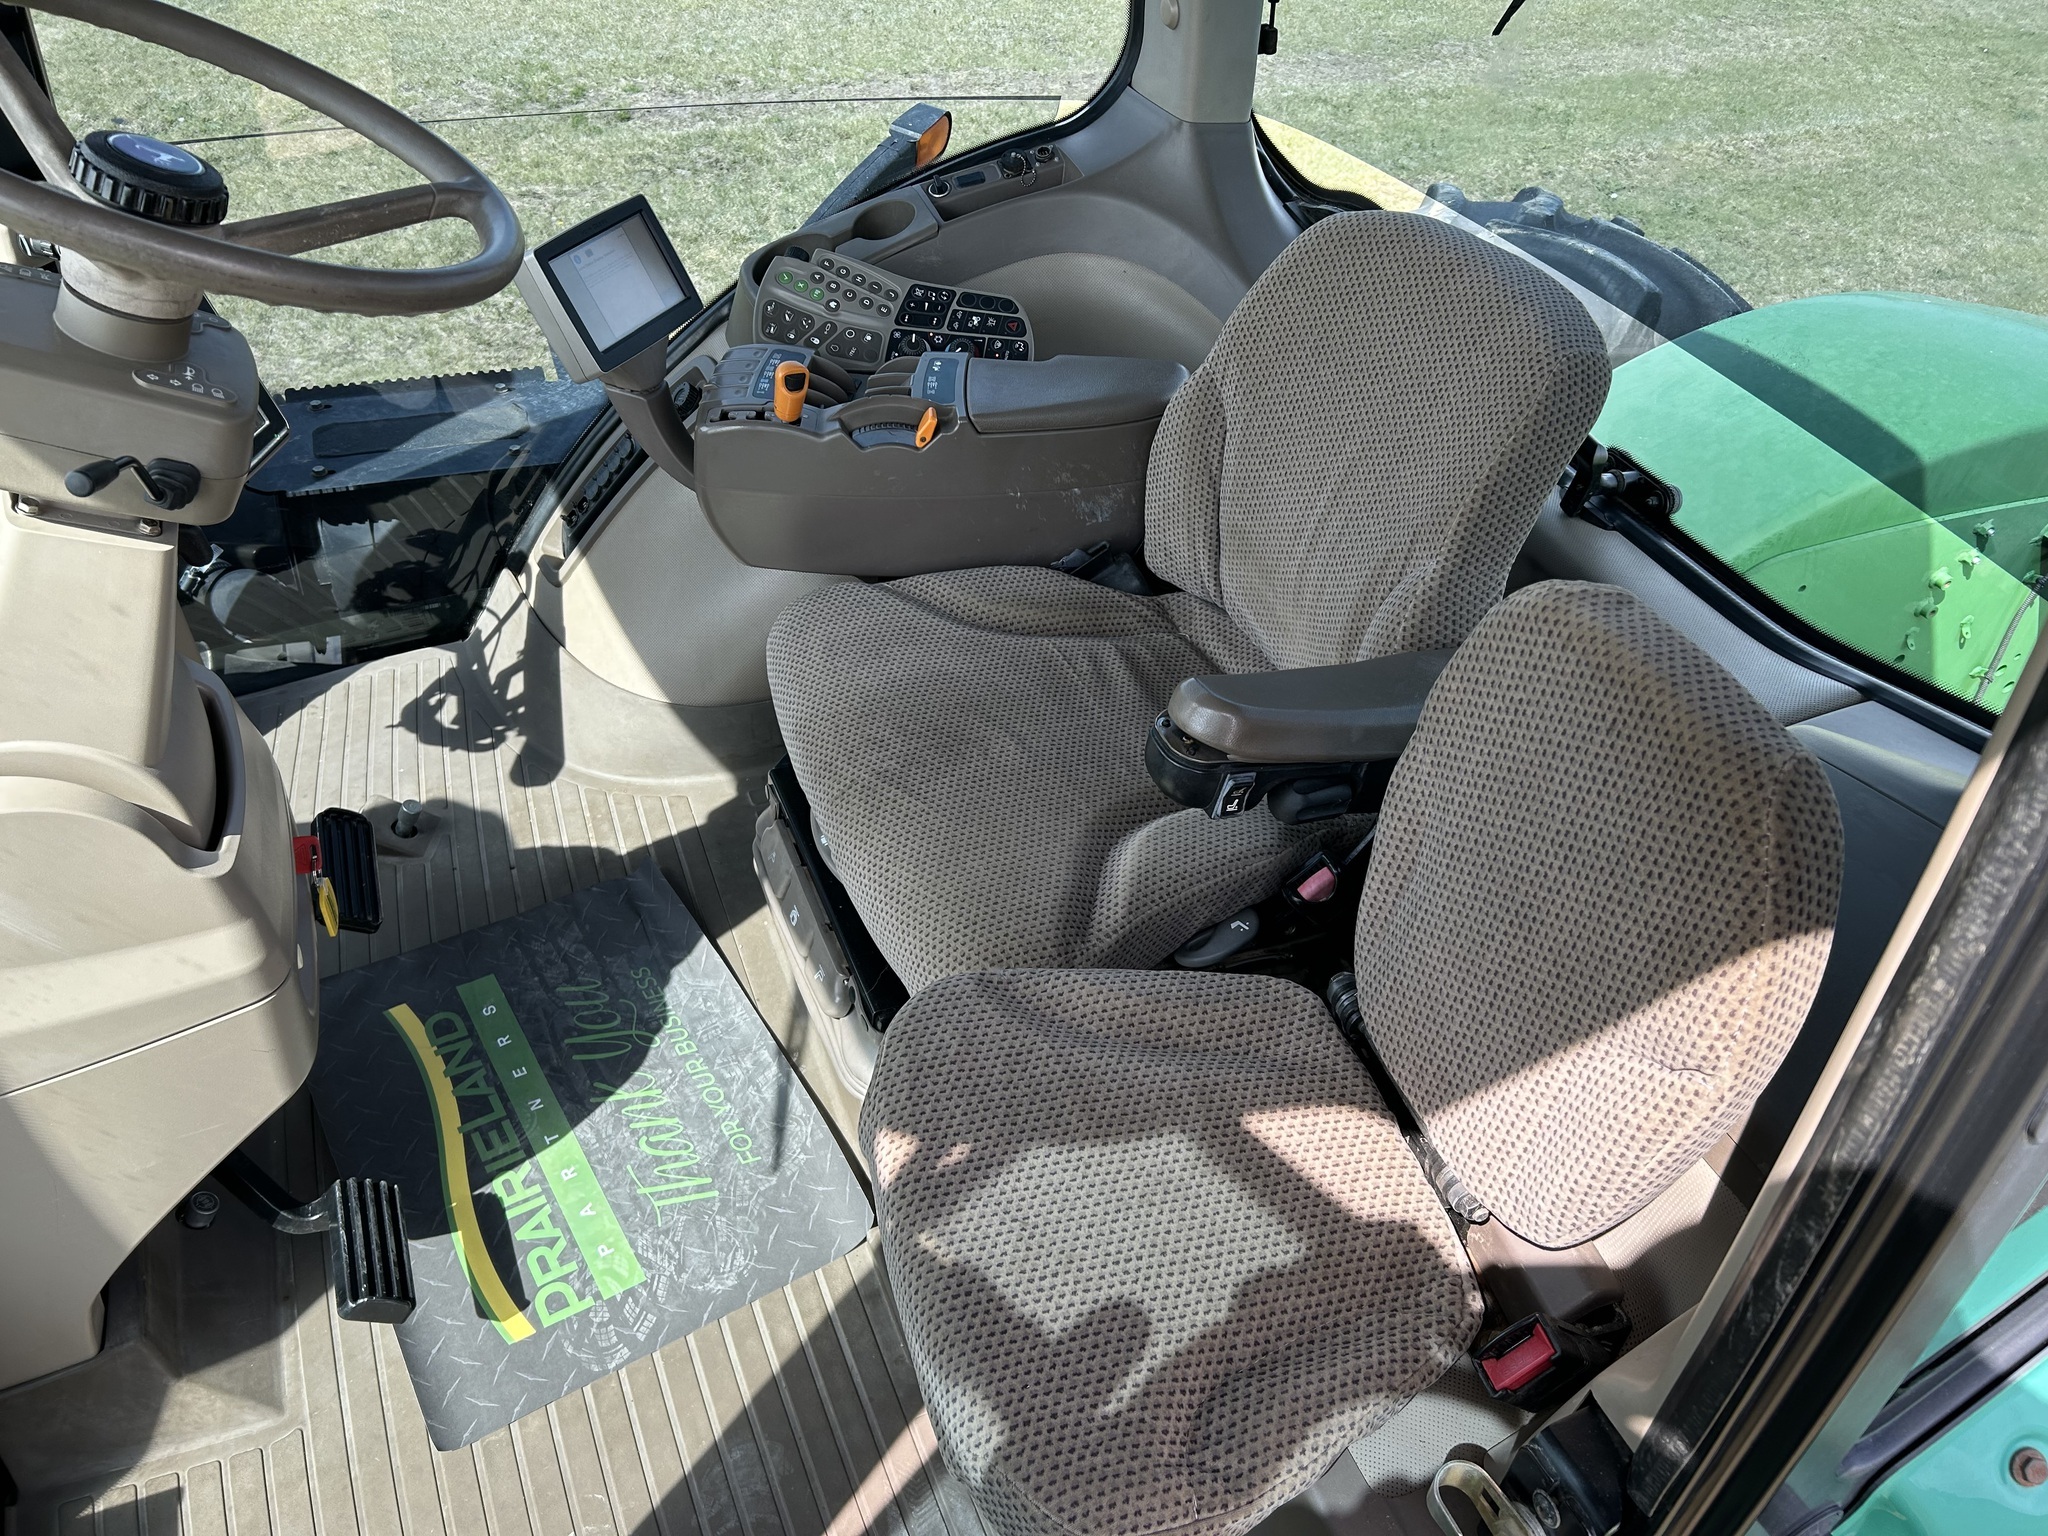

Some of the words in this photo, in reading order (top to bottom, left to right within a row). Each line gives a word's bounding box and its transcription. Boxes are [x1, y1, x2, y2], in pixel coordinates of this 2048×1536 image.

[556, 977, 661, 1060] You
[630, 966, 698, 1057] BUSINESS
[482, 1004, 615, 1258] PARTNERS
[686, 1057, 731, 1118] YOUR
[424, 1011, 595, 1328] PRAIRIELAND
[590, 1071, 719, 1227] Thank
[720, 1118, 762, 1165] FOR
